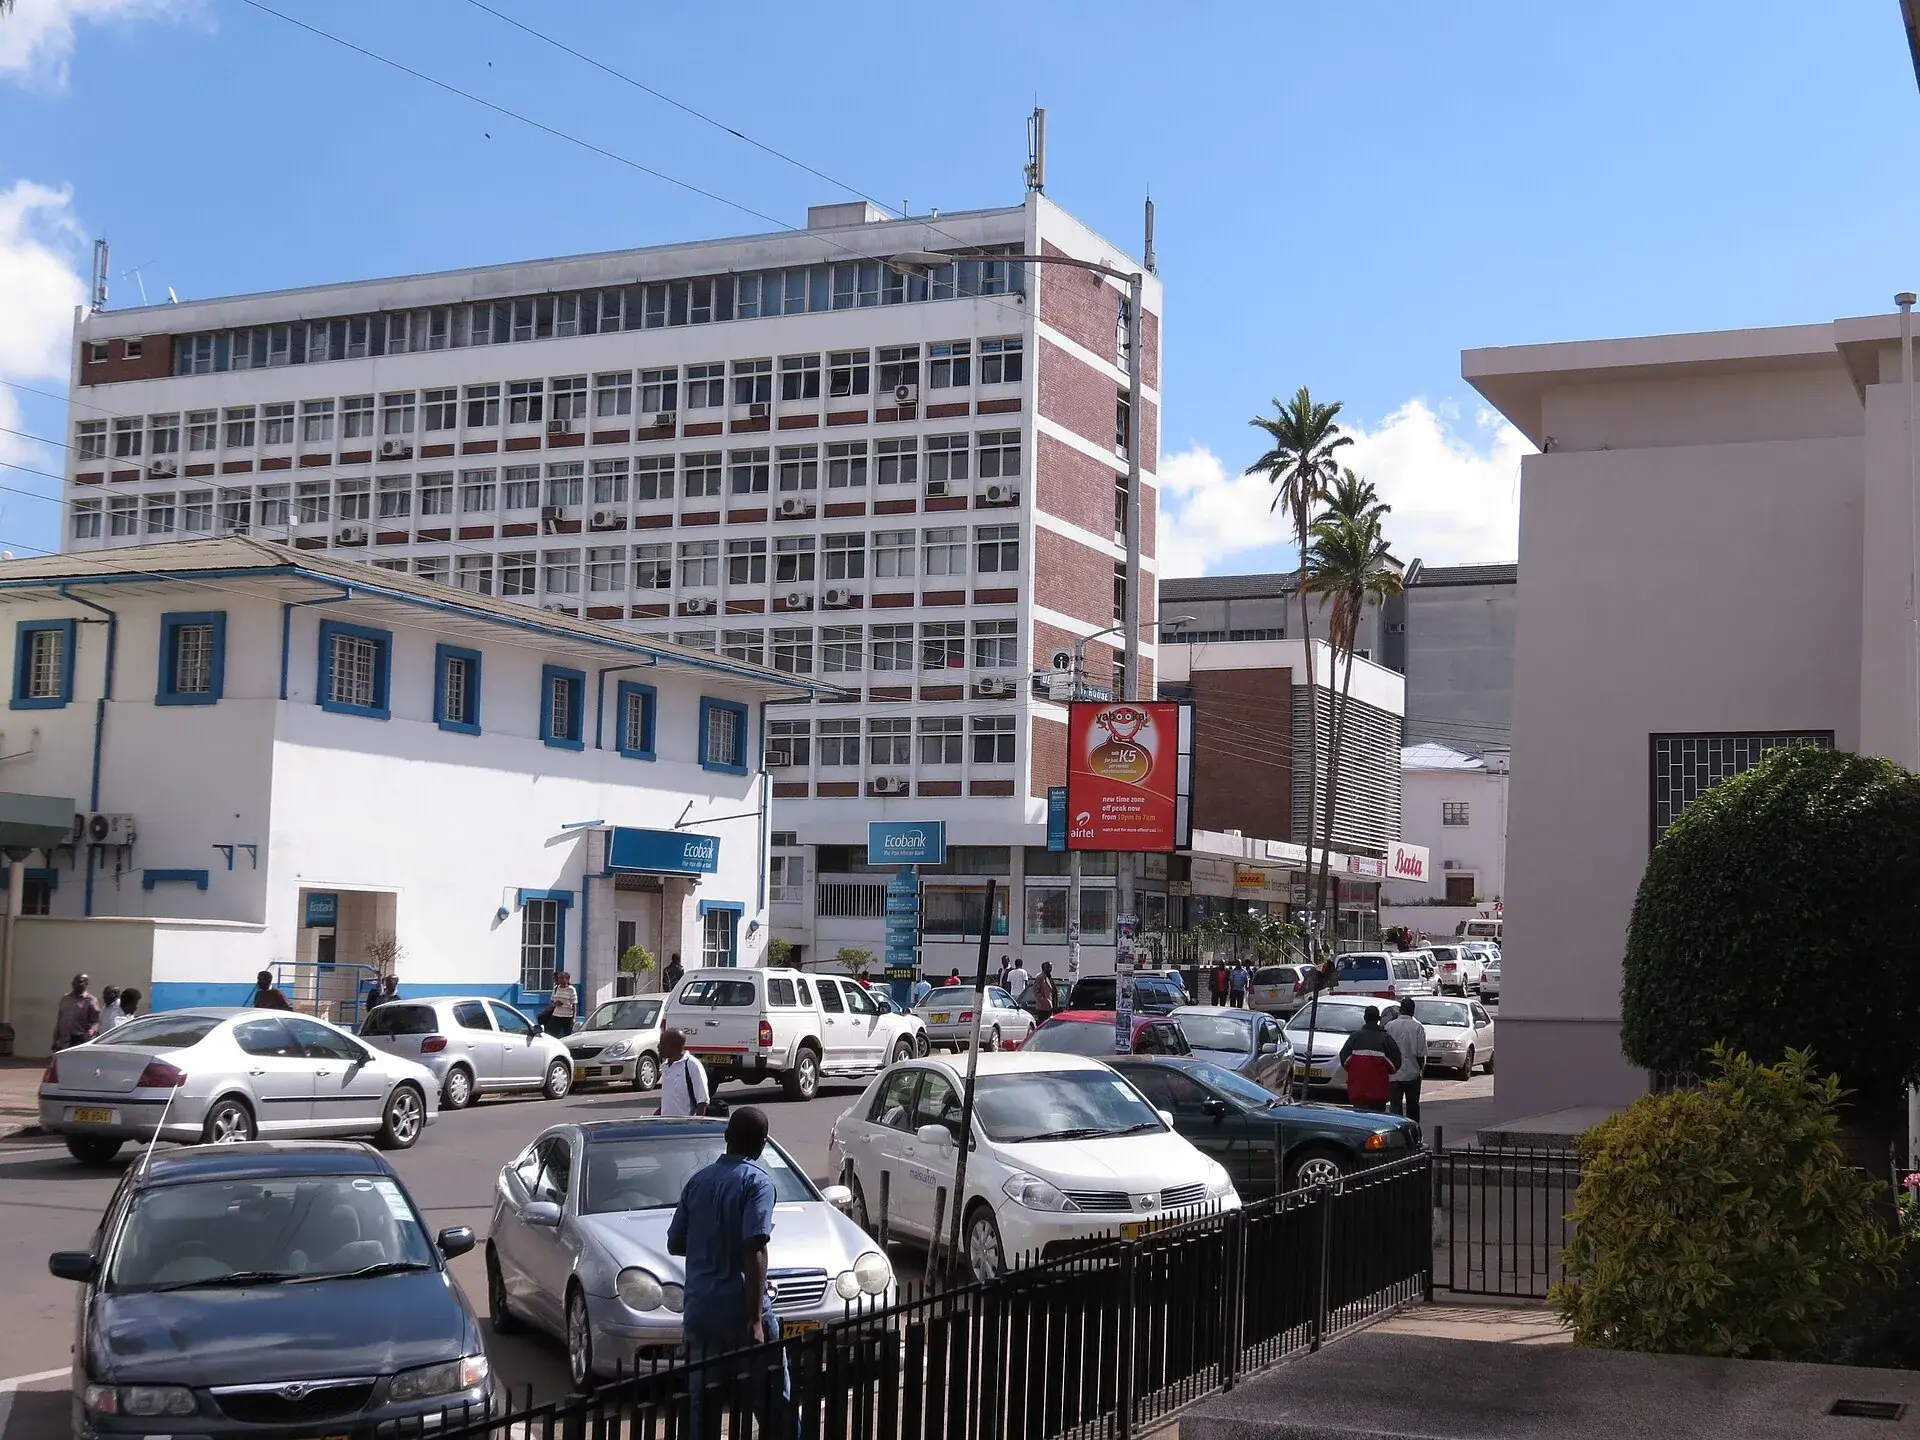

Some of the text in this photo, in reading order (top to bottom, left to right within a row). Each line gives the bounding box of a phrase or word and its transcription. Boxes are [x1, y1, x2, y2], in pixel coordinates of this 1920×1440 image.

[1119, 749, 1137, 763] K5
[1115, 795, 1131, 803] time
[1102, 804, 1112, 812] off
[1111, 803, 1127, 813] peak
[1117, 814, 1135, 822] 10pm
[885, 829, 927, 848] Ecobank
[1070, 827, 1095, 838] airtel
[683, 838, 715, 859] Ecobank
[1394, 847, 1423, 877] Bata
[309, 899, 336, 913] Ecobank
